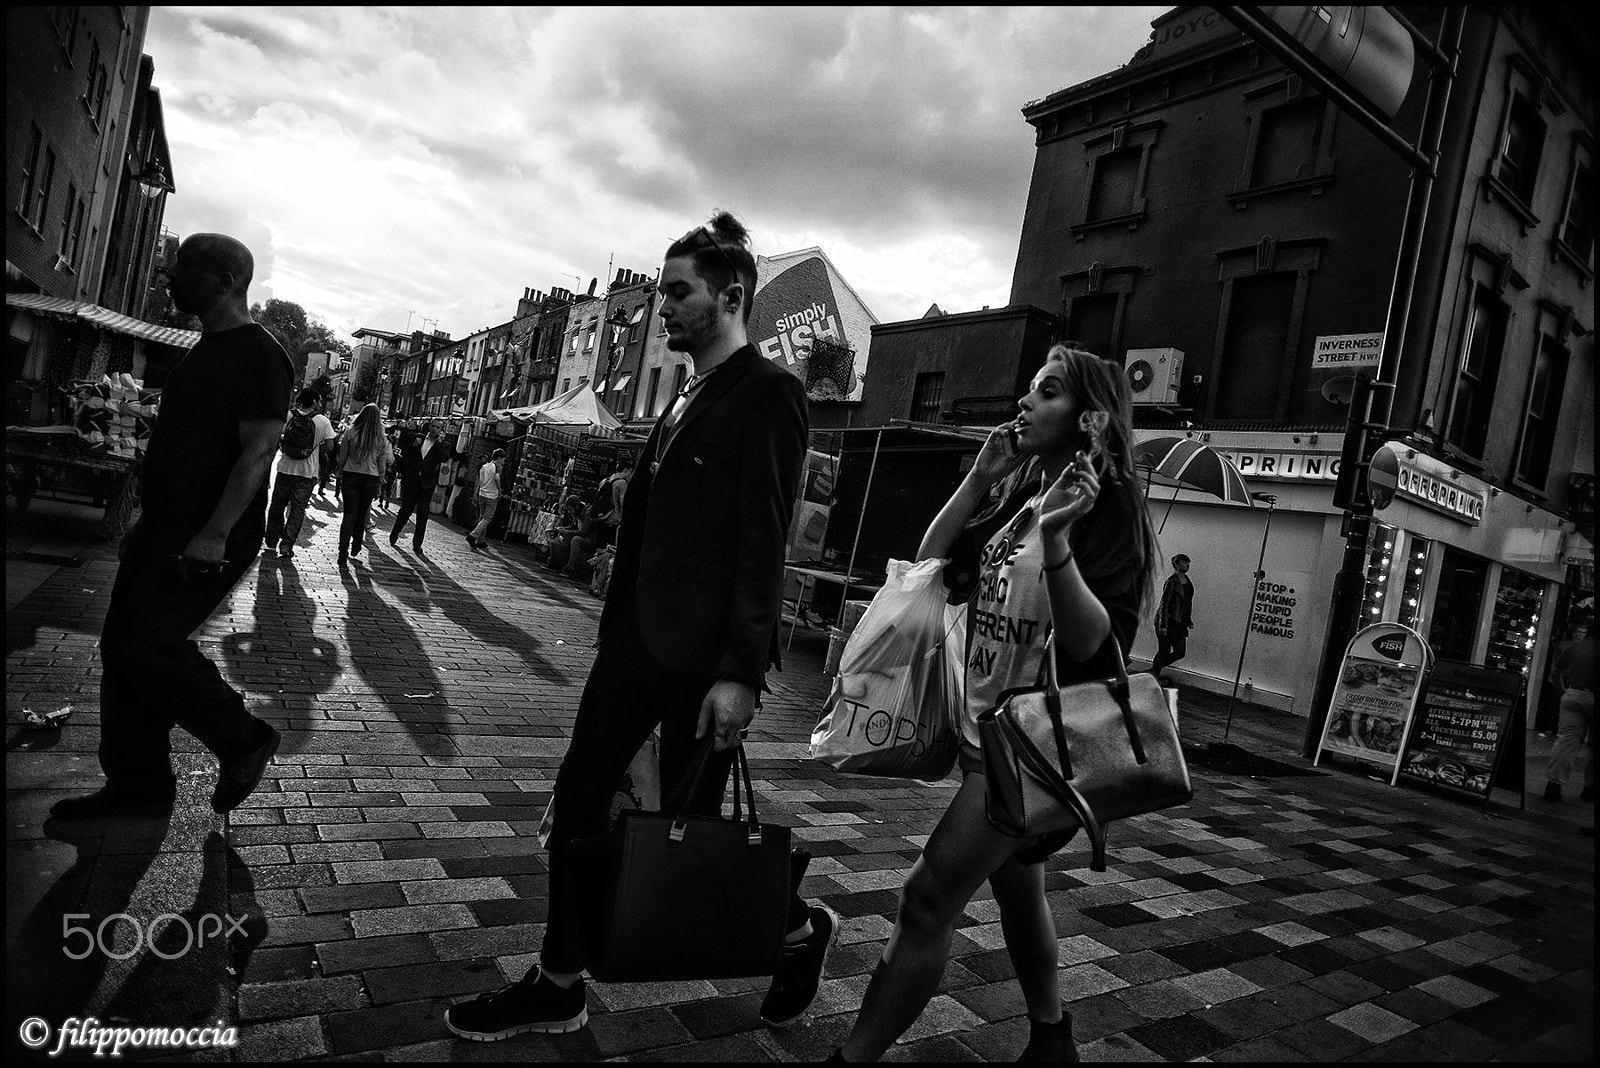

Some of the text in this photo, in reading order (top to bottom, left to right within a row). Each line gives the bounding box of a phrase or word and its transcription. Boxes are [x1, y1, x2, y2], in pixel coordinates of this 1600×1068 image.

[1159, 12, 1219, 44] JOYC
[775, 302, 826, 332] simply
[758, 315, 840, 366] FISH
[1319, 338, 1380, 350] INVERNESS
[1318, 352, 1378, 363] STREET NW1
[1226, 455, 1341, 476] PRING
[1399, 469, 1482, 518] OFFSPRING
[1258, 581, 1287, 594] STOP
[1256, 592, 1297, 607] MAKING
[1255, 602, 1292, 617] STUPID
[1252, 612, 1293, 628] PEOPLE
[1250, 622, 1295, 639] FAMOUS
[1379, 641, 1403, 651] FISH
[1345, 692, 1404, 708] FRESH BRITISH FISH
[1450, 716, 1480, 728] 5-7PM
[1470, 730, 1498, 741] £5.00
